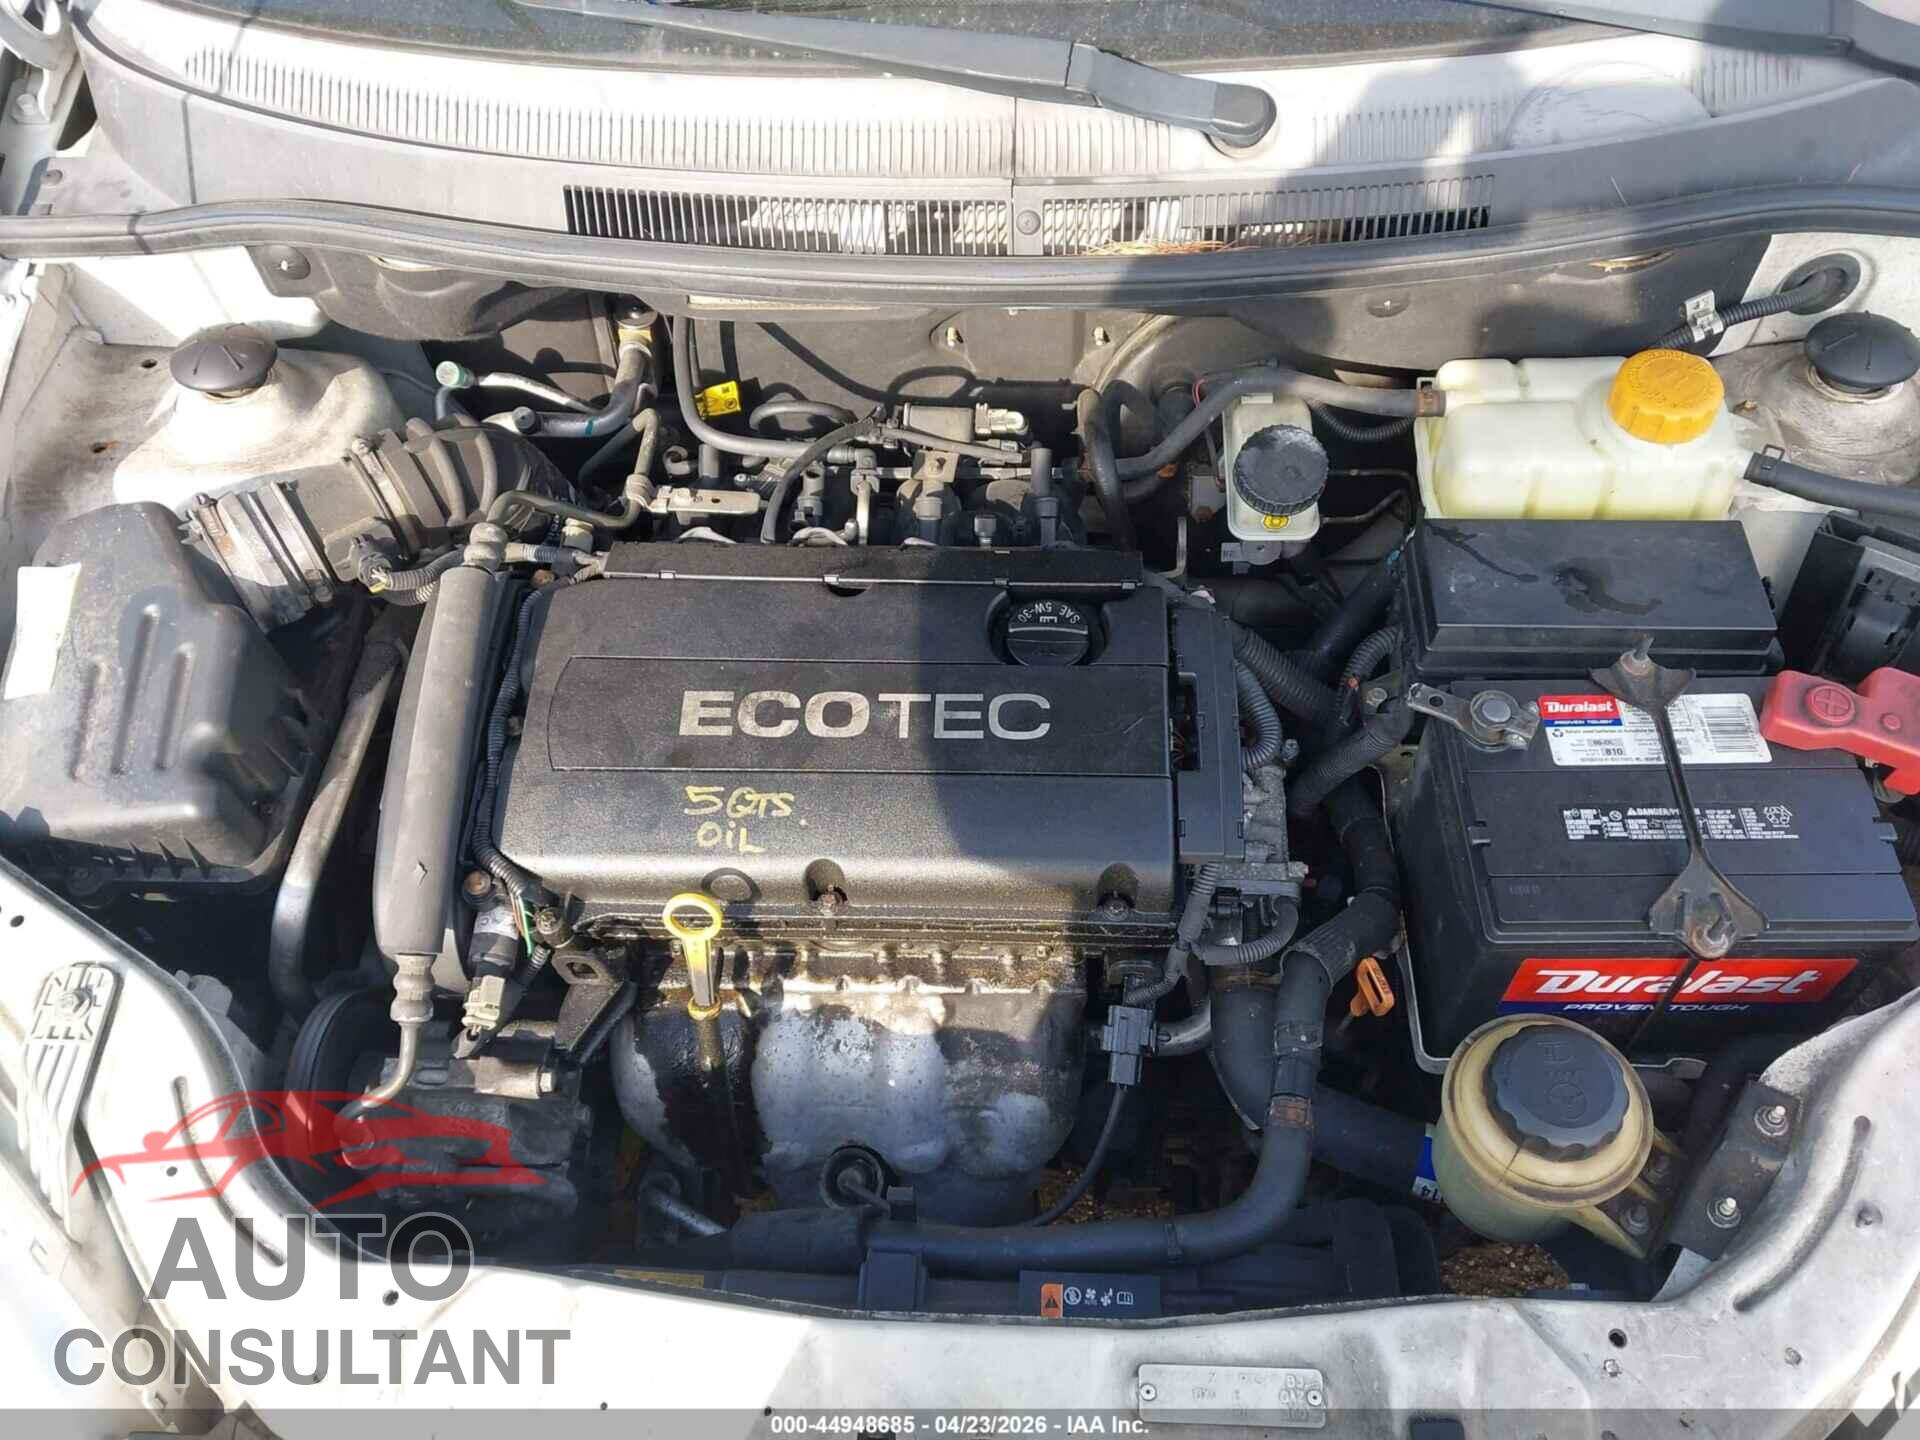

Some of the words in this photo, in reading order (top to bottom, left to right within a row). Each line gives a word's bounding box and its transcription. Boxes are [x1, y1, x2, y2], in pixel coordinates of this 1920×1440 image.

[1058, 604, 1081, 624] SAE
[679, 690, 1051, 741] ECOTEC
[1543, 701, 1614, 713] Duralast
[1535, 969, 1823, 994] Duralast
[1563, 1003, 1655, 1012] PROVEN
[1668, 1003, 1751, 1012] TOUGH
